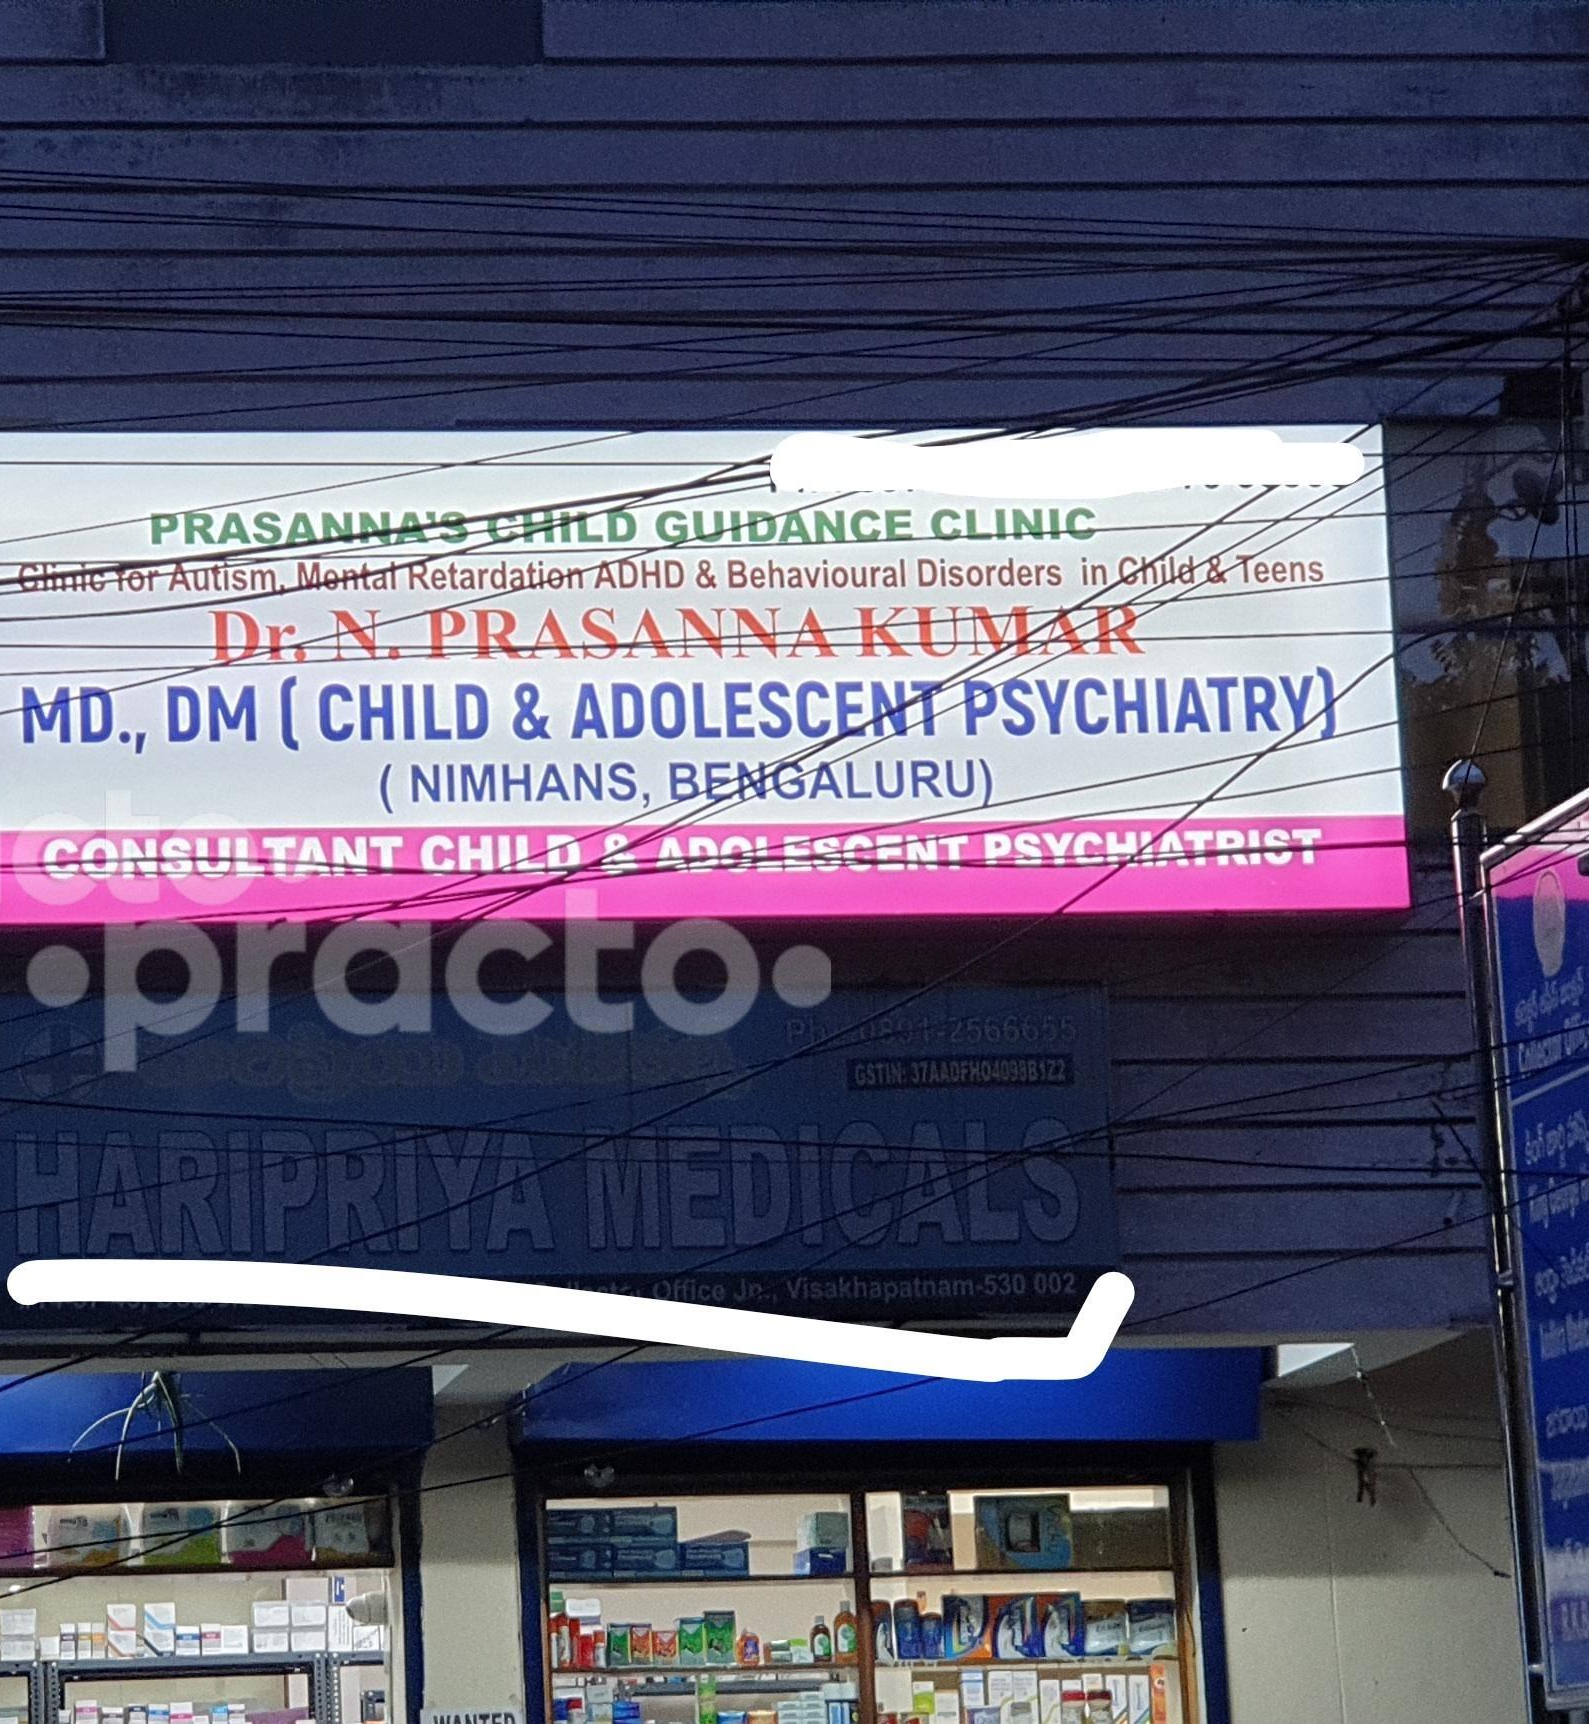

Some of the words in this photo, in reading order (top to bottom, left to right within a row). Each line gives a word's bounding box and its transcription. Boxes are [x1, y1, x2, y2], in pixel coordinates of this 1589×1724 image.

[149, 510, 469, 546] PRASANNA'S
[488, 510, 638, 544] CHILD
[656, 508, 913, 543] GUIDANCE
[930, 507, 1097, 541] CLINIC
[17, 563, 106, 593] Clinic
[115, 563, 160, 592] for
[168, 561, 286, 596] Autism,
[298, 560, 398, 591] Mental
[408, 559, 586, 591] Retardation
[595, 559, 685, 590] ADHD
[695, 559, 718, 590] &
[728, 557, 908, 589] Behavioural
[917, 556, 1063, 588] Disorders
[1081, 556, 1109, 587] in
[1118, 554, 1197, 586] Child
[1207, 555, 1228, 585] &
[1237, 553, 1326, 584] Teens
[207, 608, 308, 663] Dr.
[329, 608, 403, 662] N.
[425, 606, 837, 661] PRASANNA
[855, 604, 1147, 659] KUMAR
[20, 685, 148, 755] MD.,
[167, 685, 258, 744] DM
[318, 682, 491, 743] CHILD
[511, 681, 552, 741] &
[571, 680, 944, 741] ADOLESCENT
[963, 666, 1340, 742] PSYCHIATRY)
[410, 762, 653, 809] NIMHANS,
[668, 758, 997, 808] BENGALURU)
[43, 835, 404, 880] CONSULTANT
[420, 834, 581, 876] CHILD
[600, 834, 645, 875] &
[654, 832, 971, 876] ADOLESCENT
[984, 827, 1324, 870] PSYCHIATRIST
[854, 1061, 907, 1086] GSTIN:
[15, 1129, 554, 1256] HARIPRIYA
[584, 1115, 1082, 1252] MEDICALS
[651, 1277, 725, 1301] Office
[786, 1270, 1026, 1305] Visakhapatnam-530
[1034, 1271, 1077, 1295] 002
